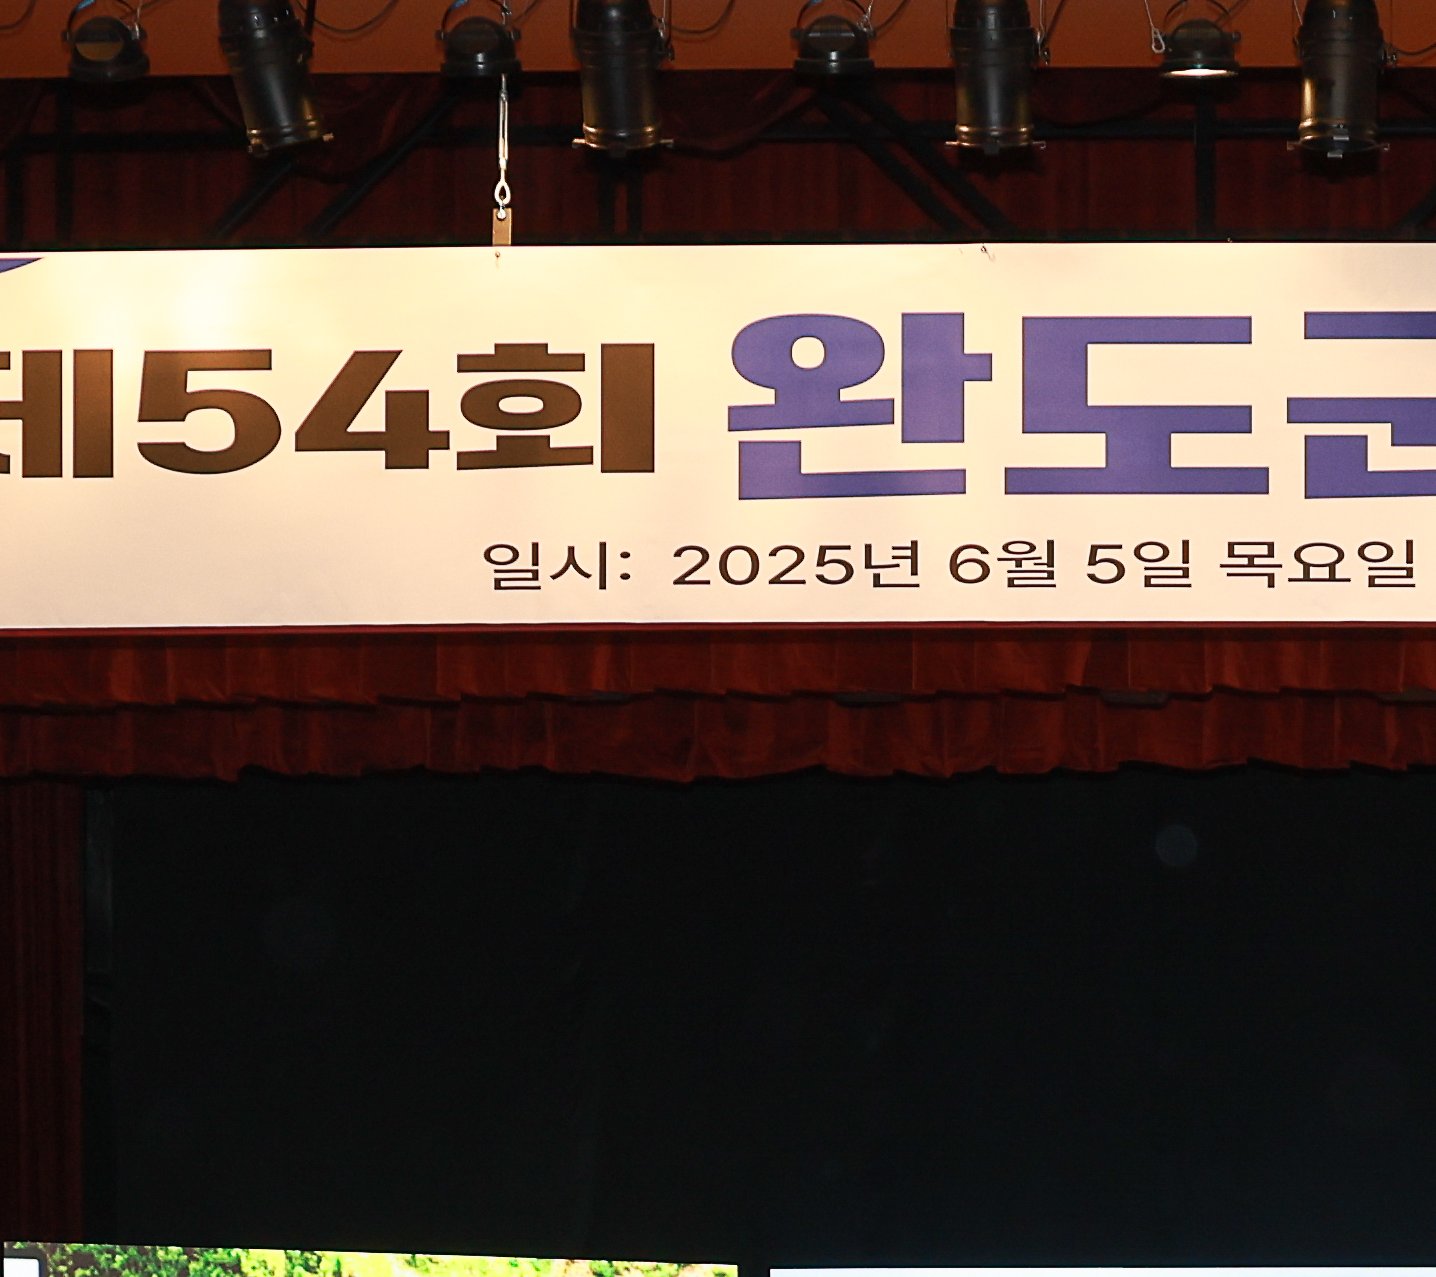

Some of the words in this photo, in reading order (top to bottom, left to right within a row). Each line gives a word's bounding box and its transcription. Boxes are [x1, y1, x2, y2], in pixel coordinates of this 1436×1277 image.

[481, 540, 634, 592] 일시:
[671, 539, 923, 590] 2025년
[947, 539, 1060, 590] 6월
[1084, 539, 1194, 590] 5일
[1218, 539, 1418, 590] 목요일
